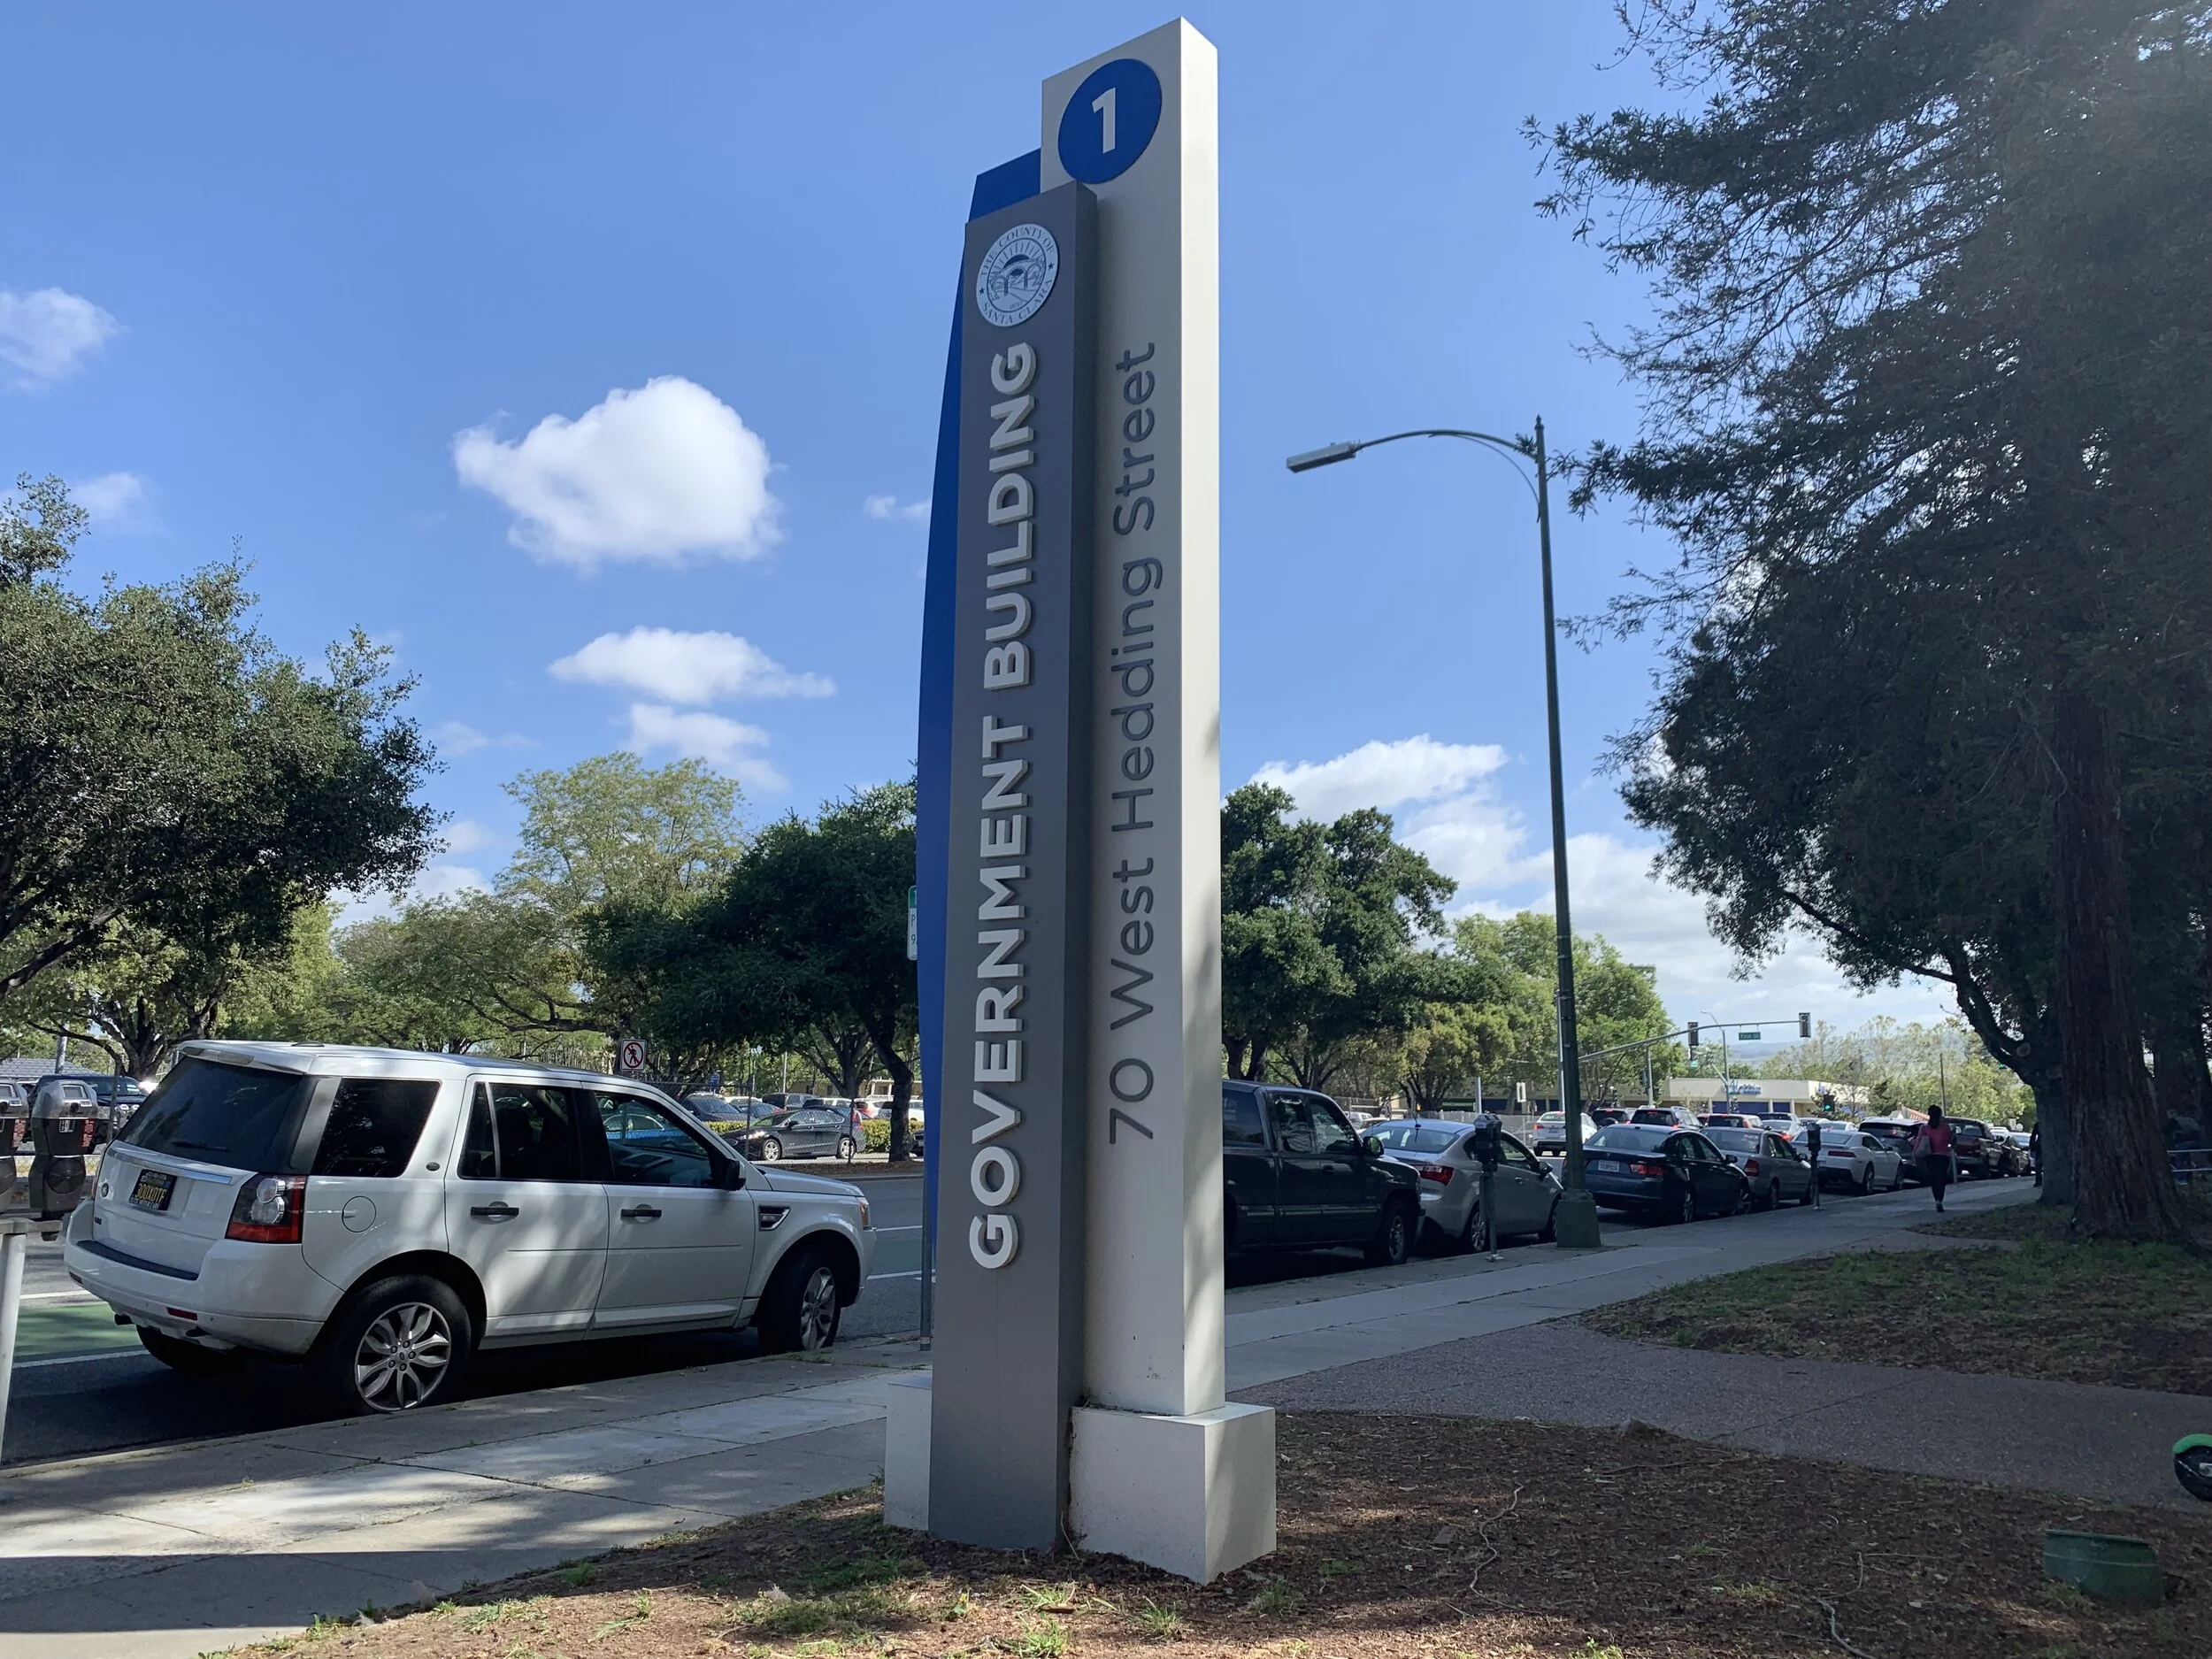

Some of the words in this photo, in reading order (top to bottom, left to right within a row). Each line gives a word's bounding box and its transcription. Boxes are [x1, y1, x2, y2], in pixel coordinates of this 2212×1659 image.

[1092, 87, 1116, 154] 1
[981, 250, 997, 277] THE
[999, 227, 1042, 248] COUNTY
[1043, 236, 1055, 254] OF
[982, 302, 1013, 325] SANTA
[1018, 279, 1052, 319] CLARA
[984, 342, 1036, 690] BUILDING
[1113, 342, 1156, 535] Street
[1110, 557, 1163, 832] Hedding
[969, 715, 1028, 1269] GOVERNMENT
[1110, 857, 1154, 1030] West
[1110, 1058, 1154, 1145] 70
